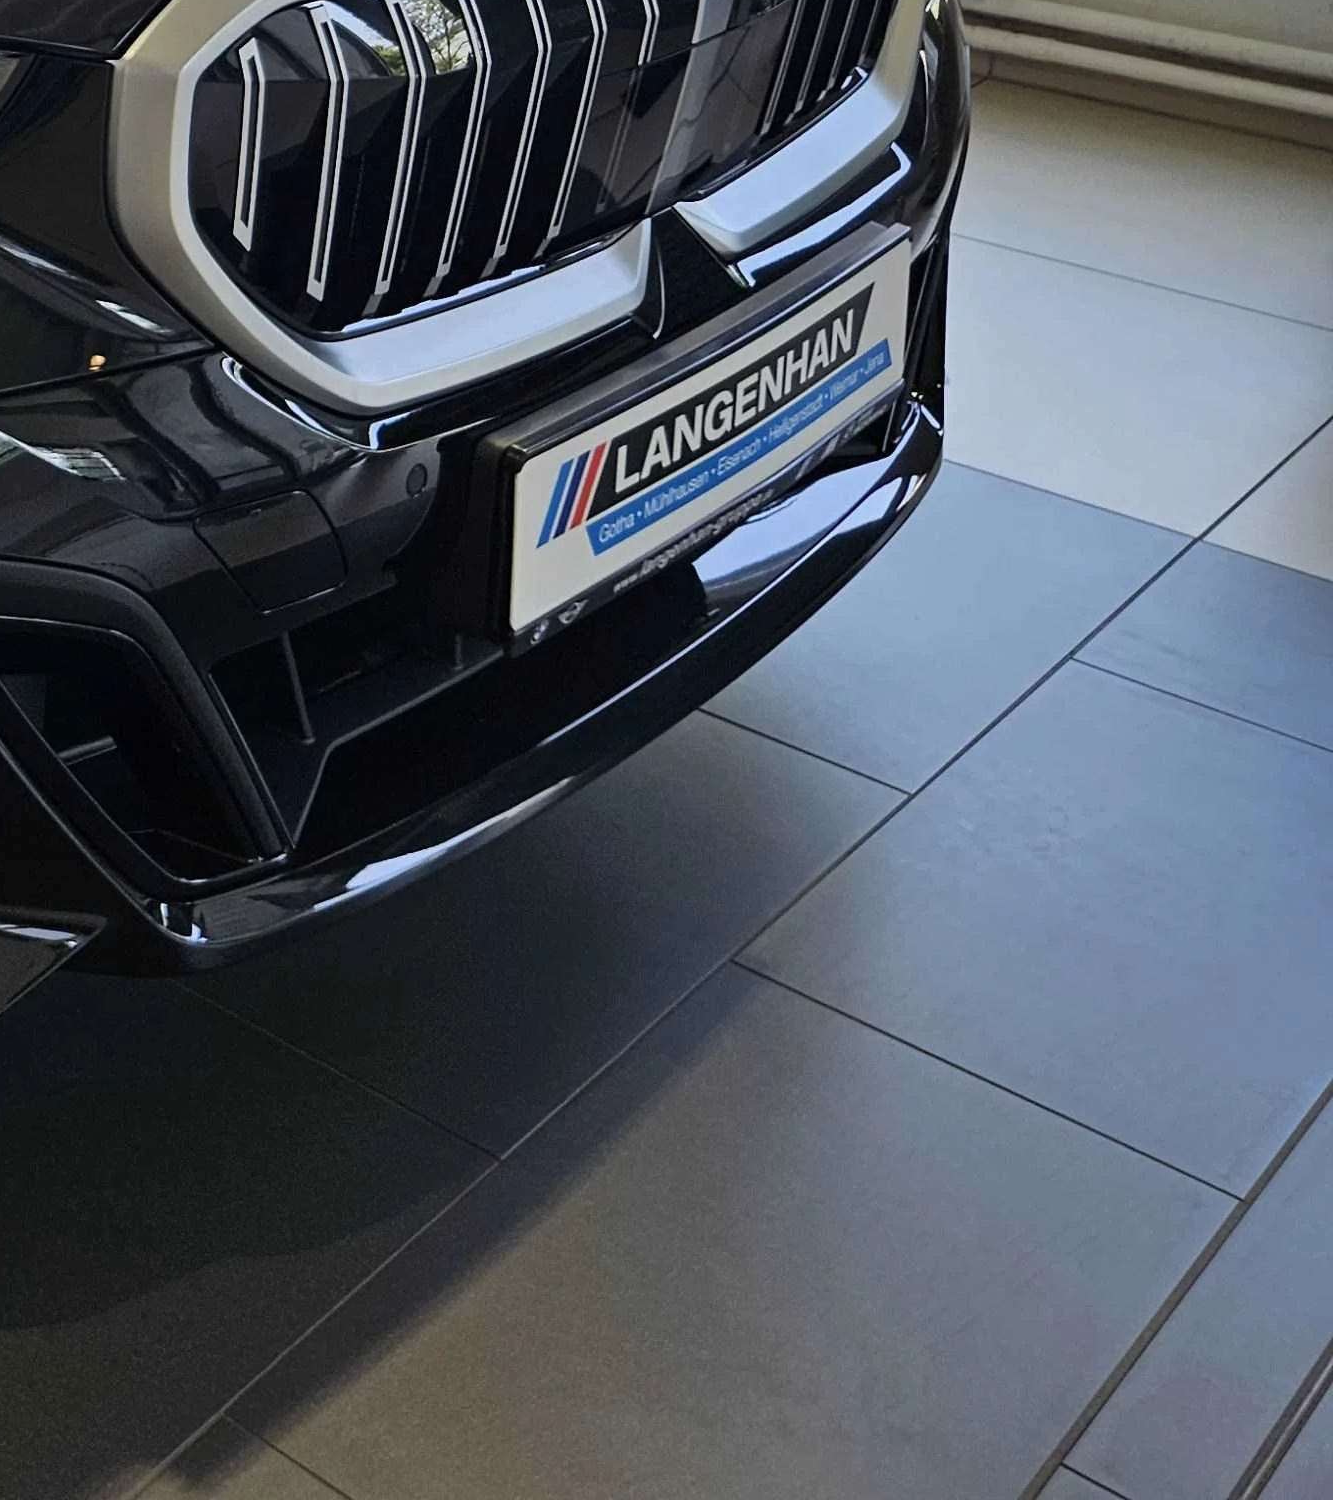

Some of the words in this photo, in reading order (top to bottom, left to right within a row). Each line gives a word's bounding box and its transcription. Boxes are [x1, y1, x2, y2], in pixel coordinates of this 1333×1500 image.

[614, 309, 855, 493] LANGENHAN
[598, 514, 635, 543] Gotha
[643, 470, 710, 518] Mühlhausen
[716, 437, 762, 477] Eisenach
